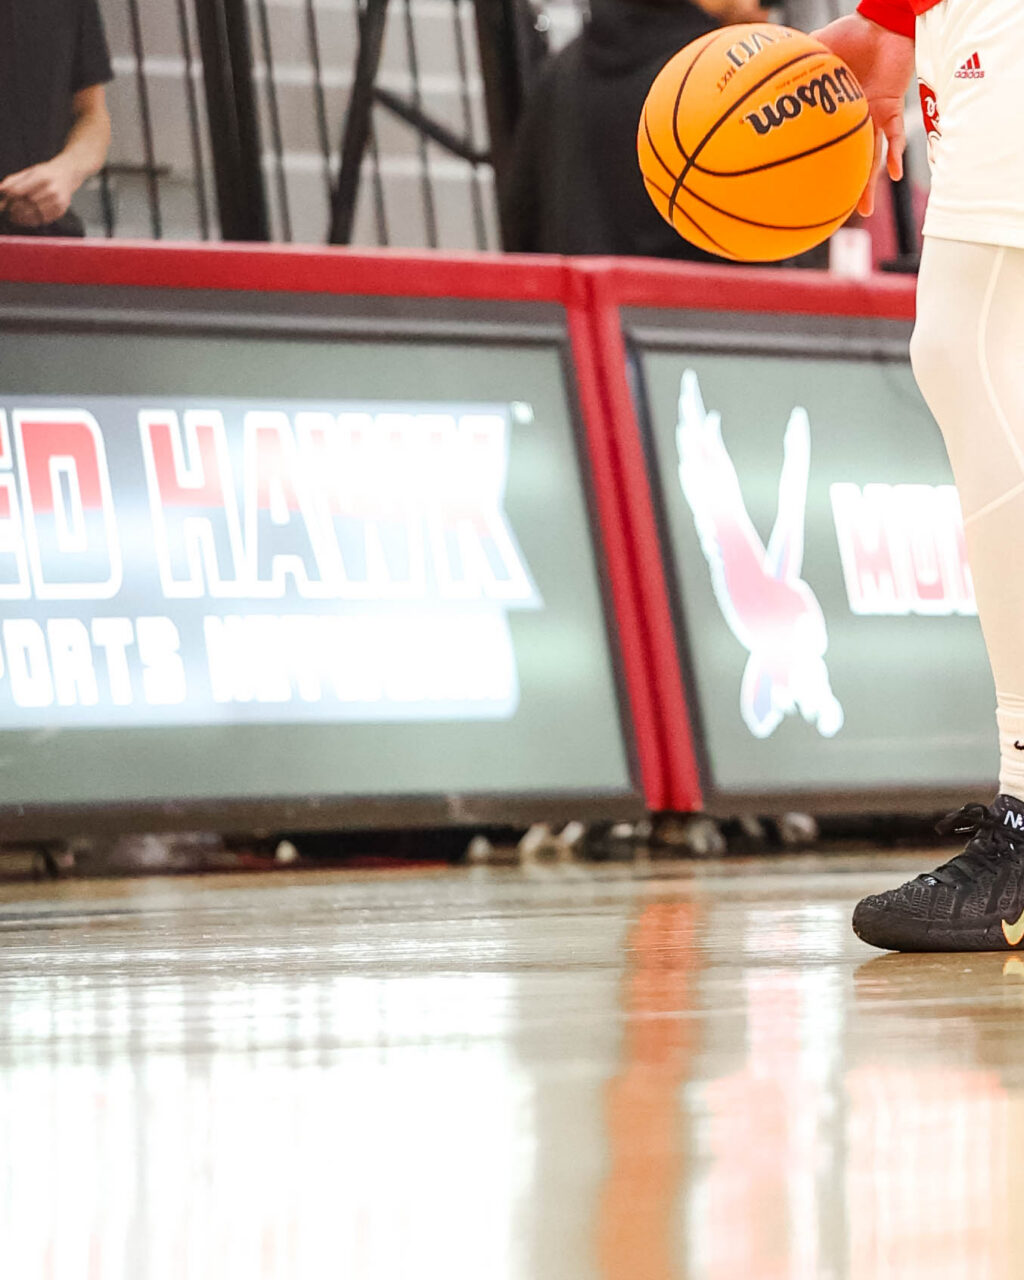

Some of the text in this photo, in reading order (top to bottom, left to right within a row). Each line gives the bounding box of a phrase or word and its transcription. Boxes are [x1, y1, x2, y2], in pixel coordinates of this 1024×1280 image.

[744, 66, 863, 135] Wilson
[954, 70, 985, 79] adidas
[0, 616, 186, 707] ORTS
